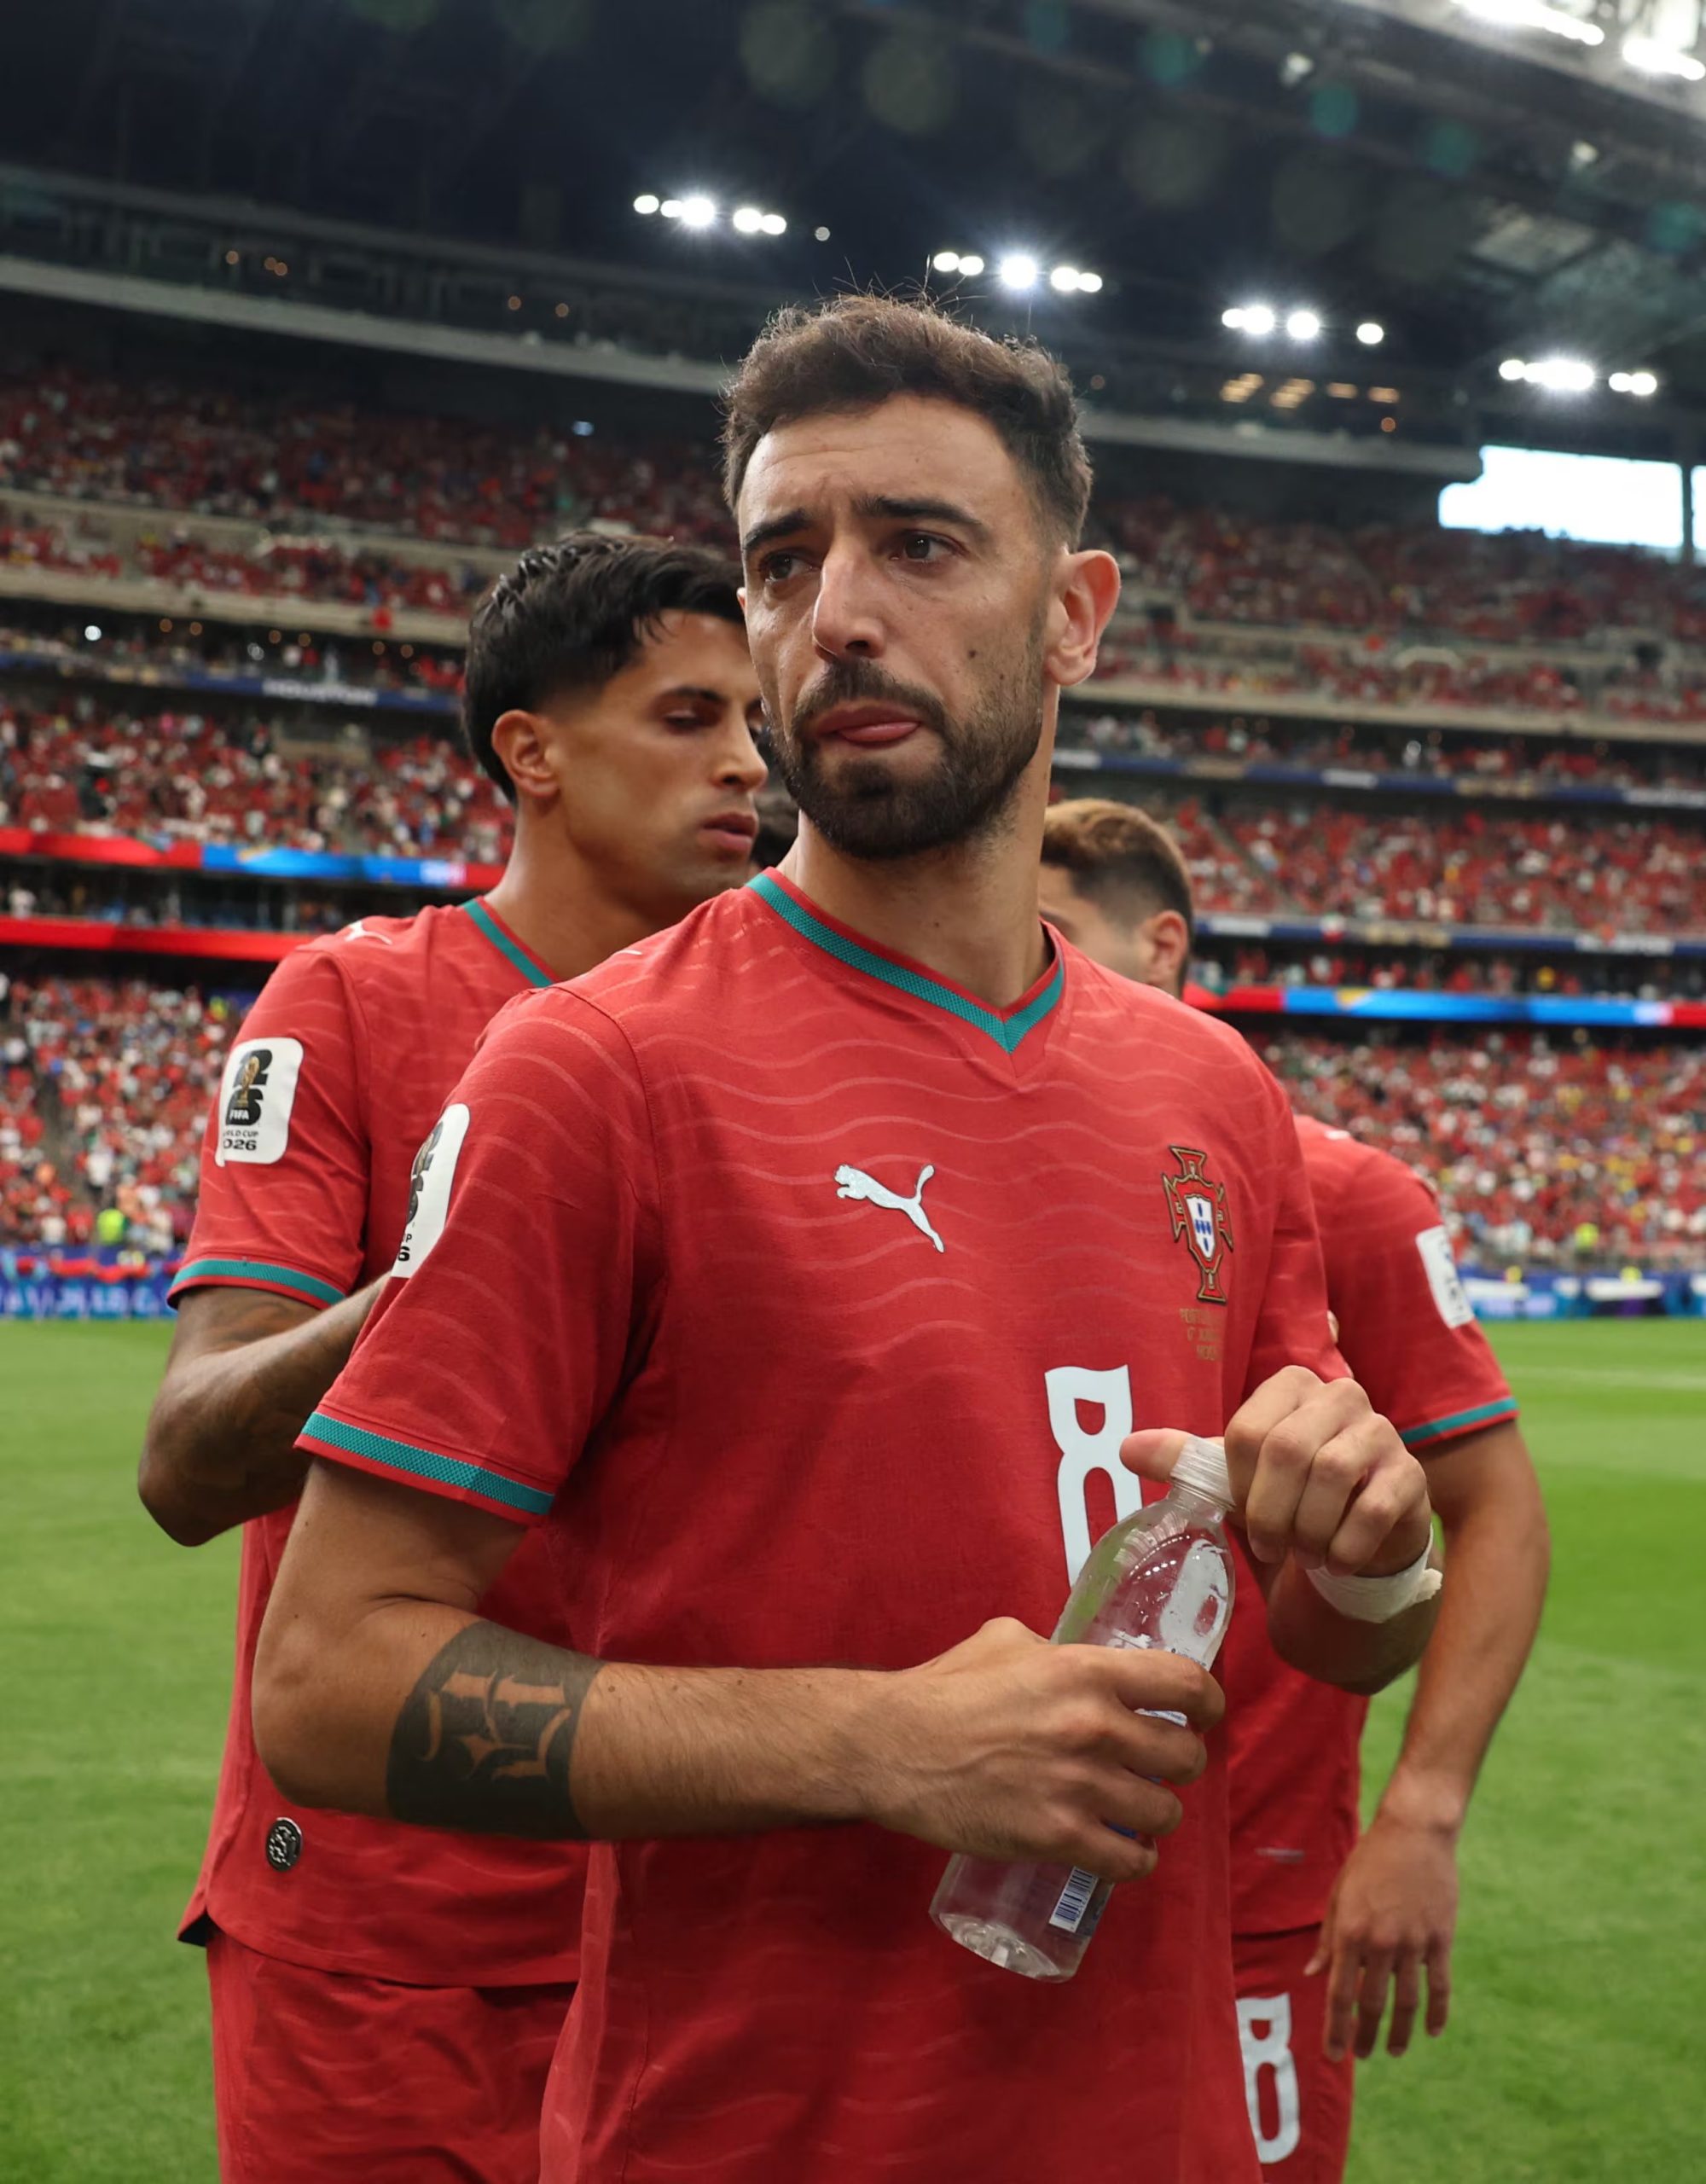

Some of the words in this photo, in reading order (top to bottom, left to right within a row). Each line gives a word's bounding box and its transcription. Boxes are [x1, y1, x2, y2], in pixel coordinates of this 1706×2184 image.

[229, 1108, 250, 1120] FIFA
[243, 1130, 258, 1138] CUP
[223, 1138, 257, 1151] 026
[1044, 1363, 1143, 1592] 8
[1234, 1991, 1301, 2164] 8
